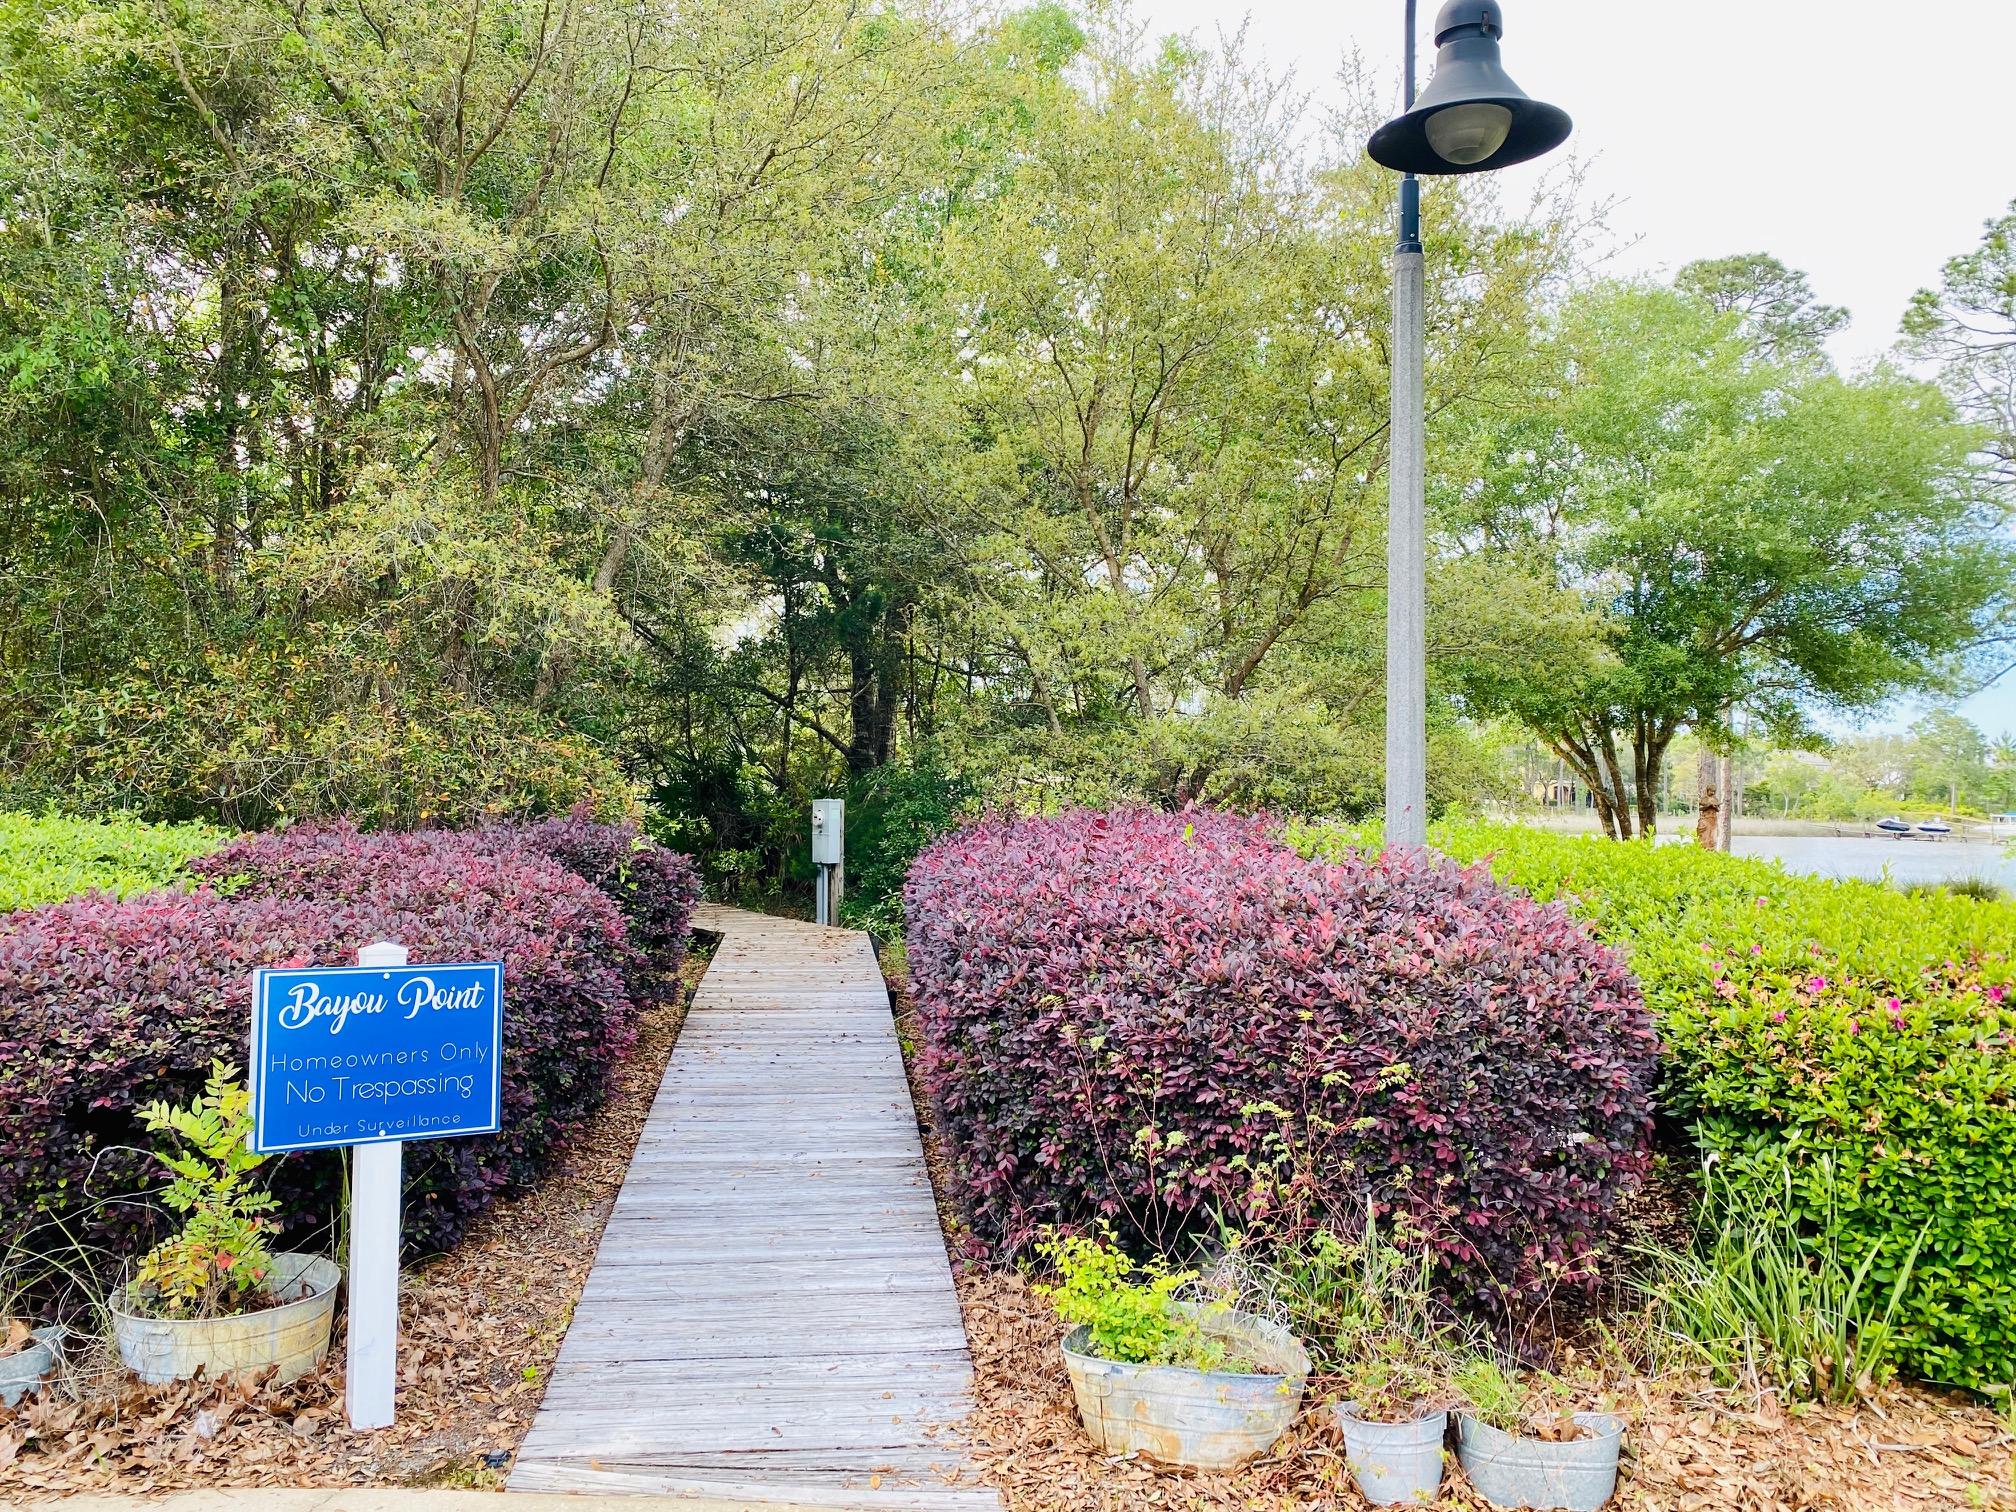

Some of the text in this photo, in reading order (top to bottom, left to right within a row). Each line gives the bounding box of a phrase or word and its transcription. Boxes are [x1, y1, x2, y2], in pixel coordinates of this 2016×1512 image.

[278, 976, 485, 1035] Bayou Point
[271, 1041, 488, 1072] Homeowners Only
[286, 1072, 474, 1104] No Trespassing
[298, 1114, 461, 1137] Under Surveillance
